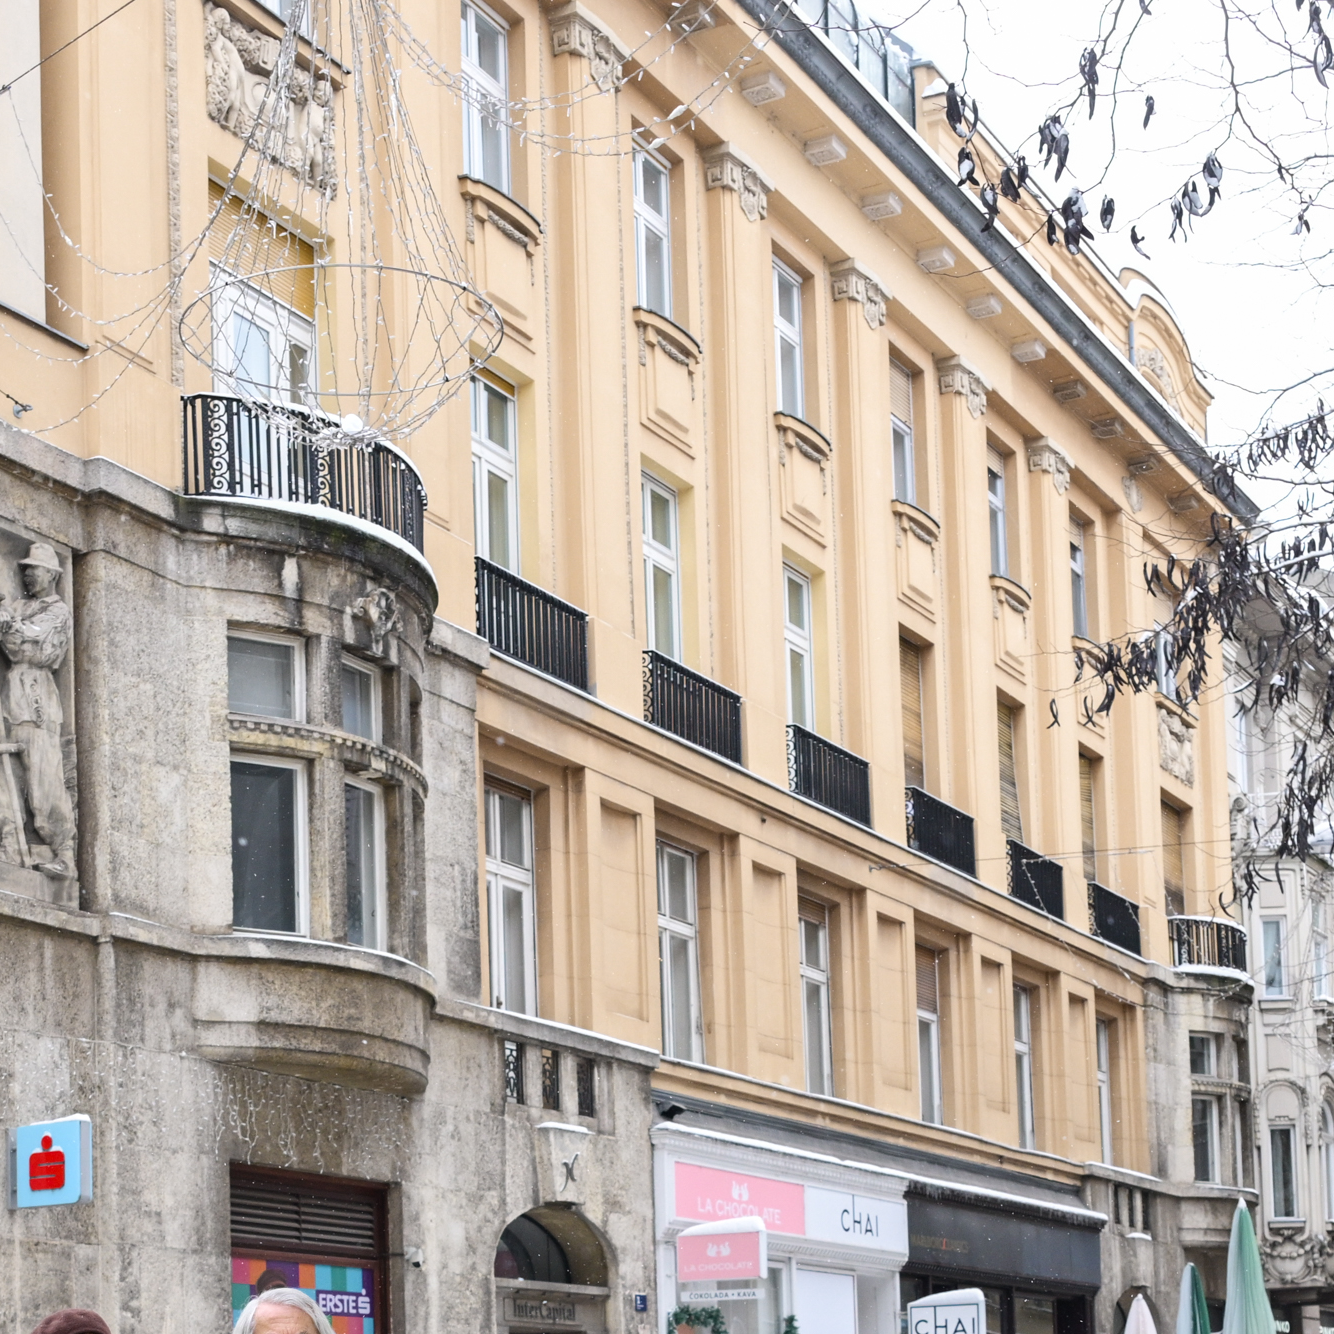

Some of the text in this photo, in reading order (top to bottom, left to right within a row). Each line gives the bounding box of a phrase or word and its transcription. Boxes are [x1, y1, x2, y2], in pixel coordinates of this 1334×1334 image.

[697, 1197, 713, 1214] LA
[840, 1194, 879, 1237] CHAI
[684, 1260, 754, 1273] LA CHOCOLATE
[318, 1293, 357, 1314] ERSTE
[689, 1290, 757, 1300] ČOKOLADA KAVA
